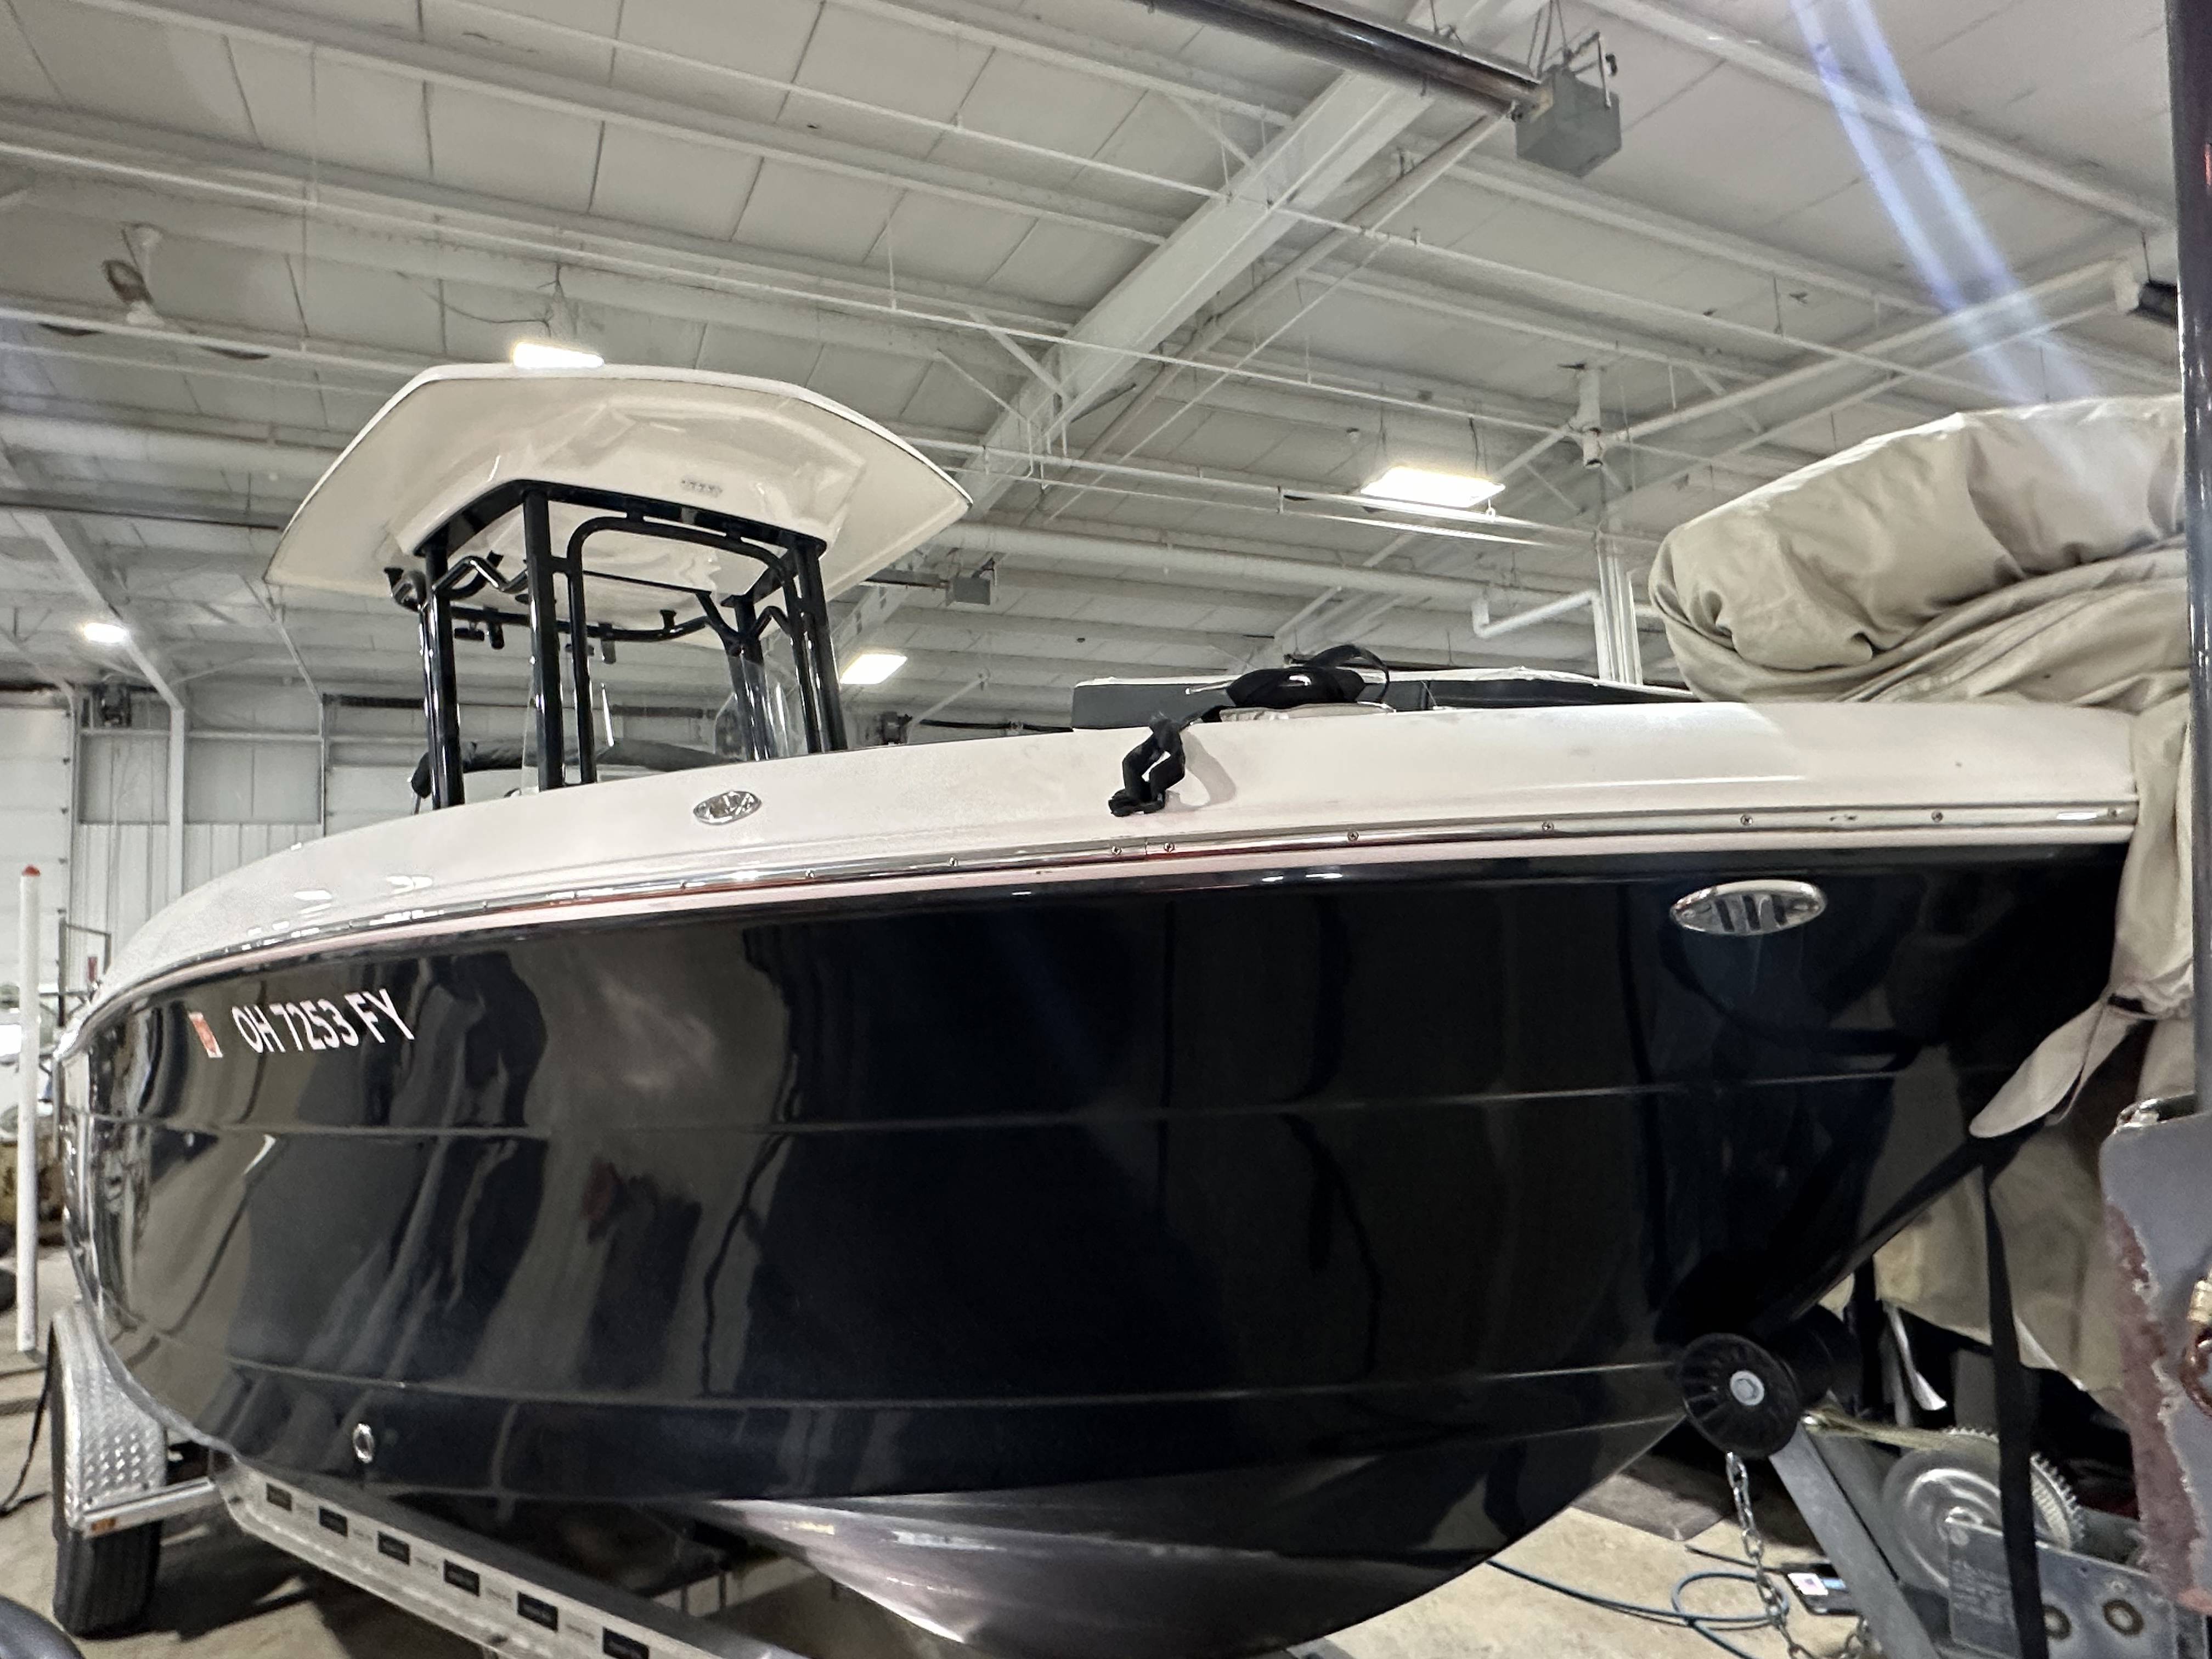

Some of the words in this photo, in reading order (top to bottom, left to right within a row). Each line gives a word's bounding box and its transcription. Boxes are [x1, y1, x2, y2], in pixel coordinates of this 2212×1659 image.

[232, 1006, 286, 1053] OH
[269, 999, 359, 1052] 7253
[345, 988, 415, 1043] FY
